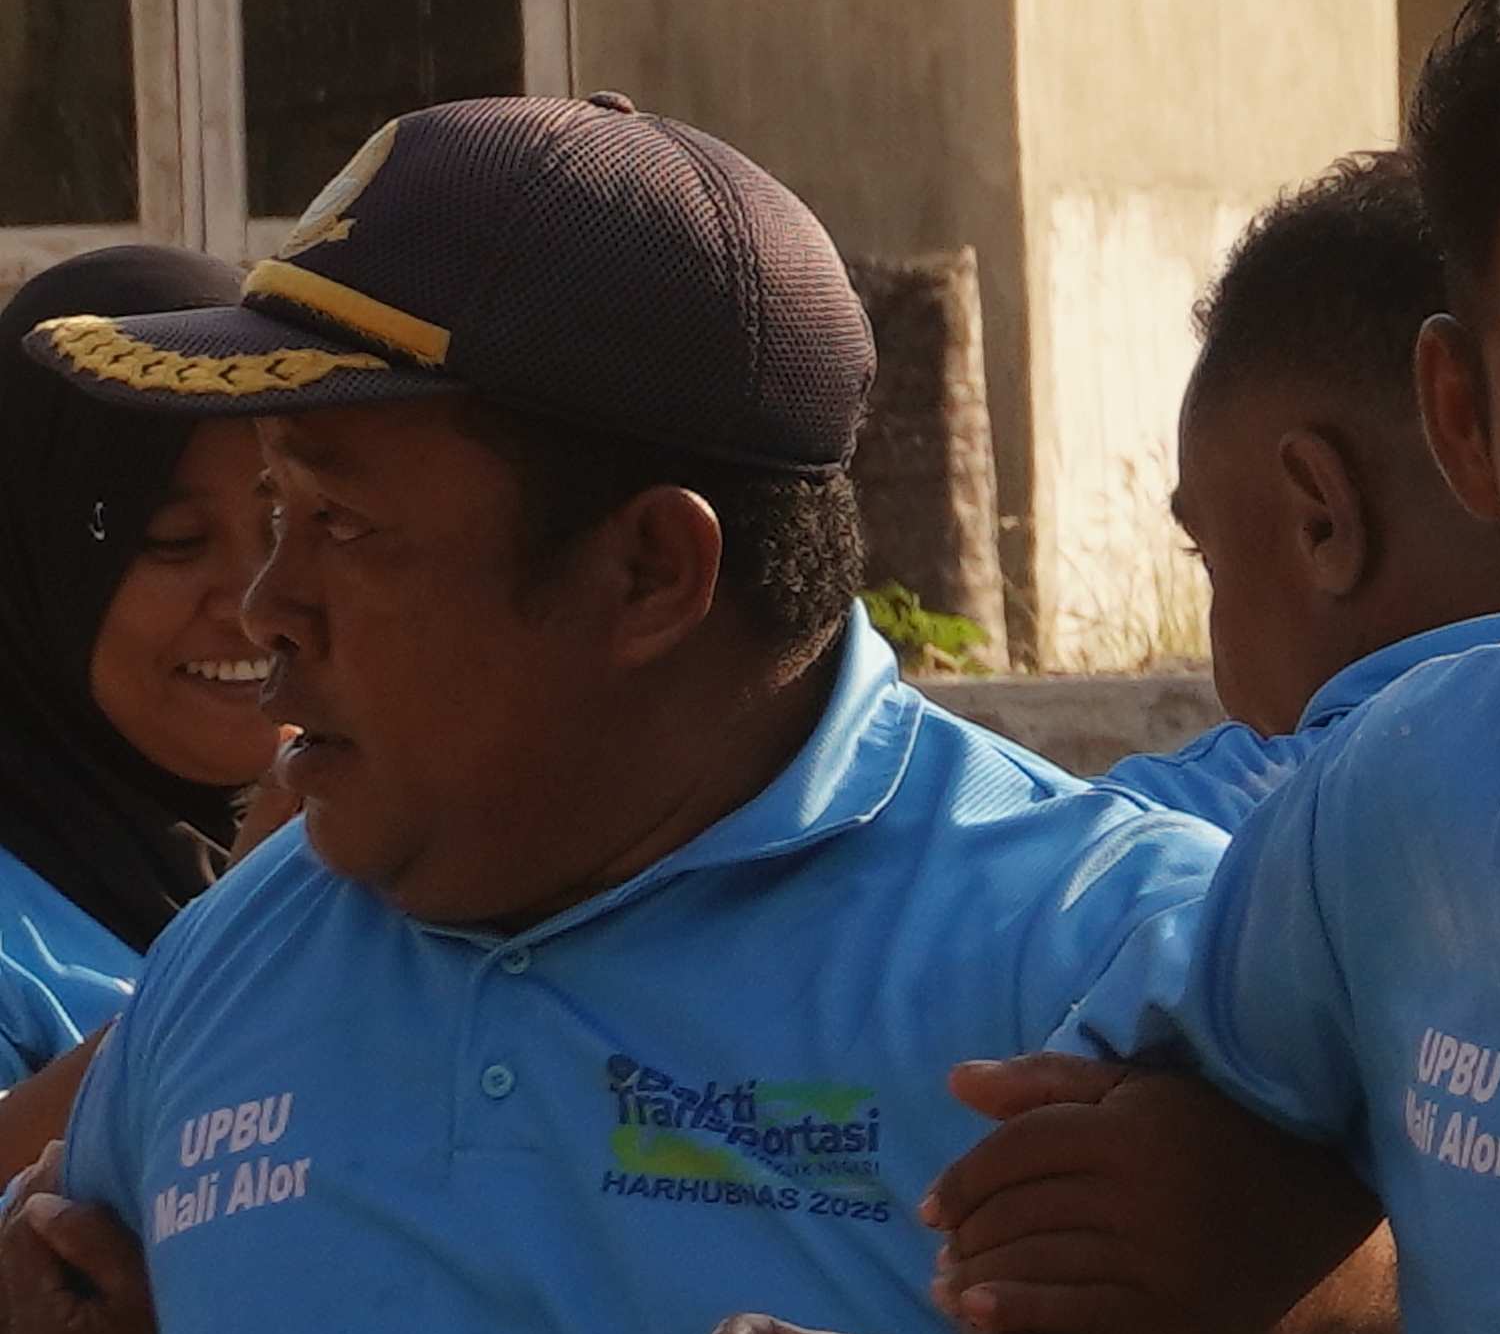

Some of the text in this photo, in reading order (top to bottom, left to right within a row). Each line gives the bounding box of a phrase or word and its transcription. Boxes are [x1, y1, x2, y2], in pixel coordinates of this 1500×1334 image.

[181, 1092, 293, 1167] UPBU
[155, 1155, 311, 1244] Mali Alor
[601, 1170, 890, 1223] HARHUBNAS 2025
